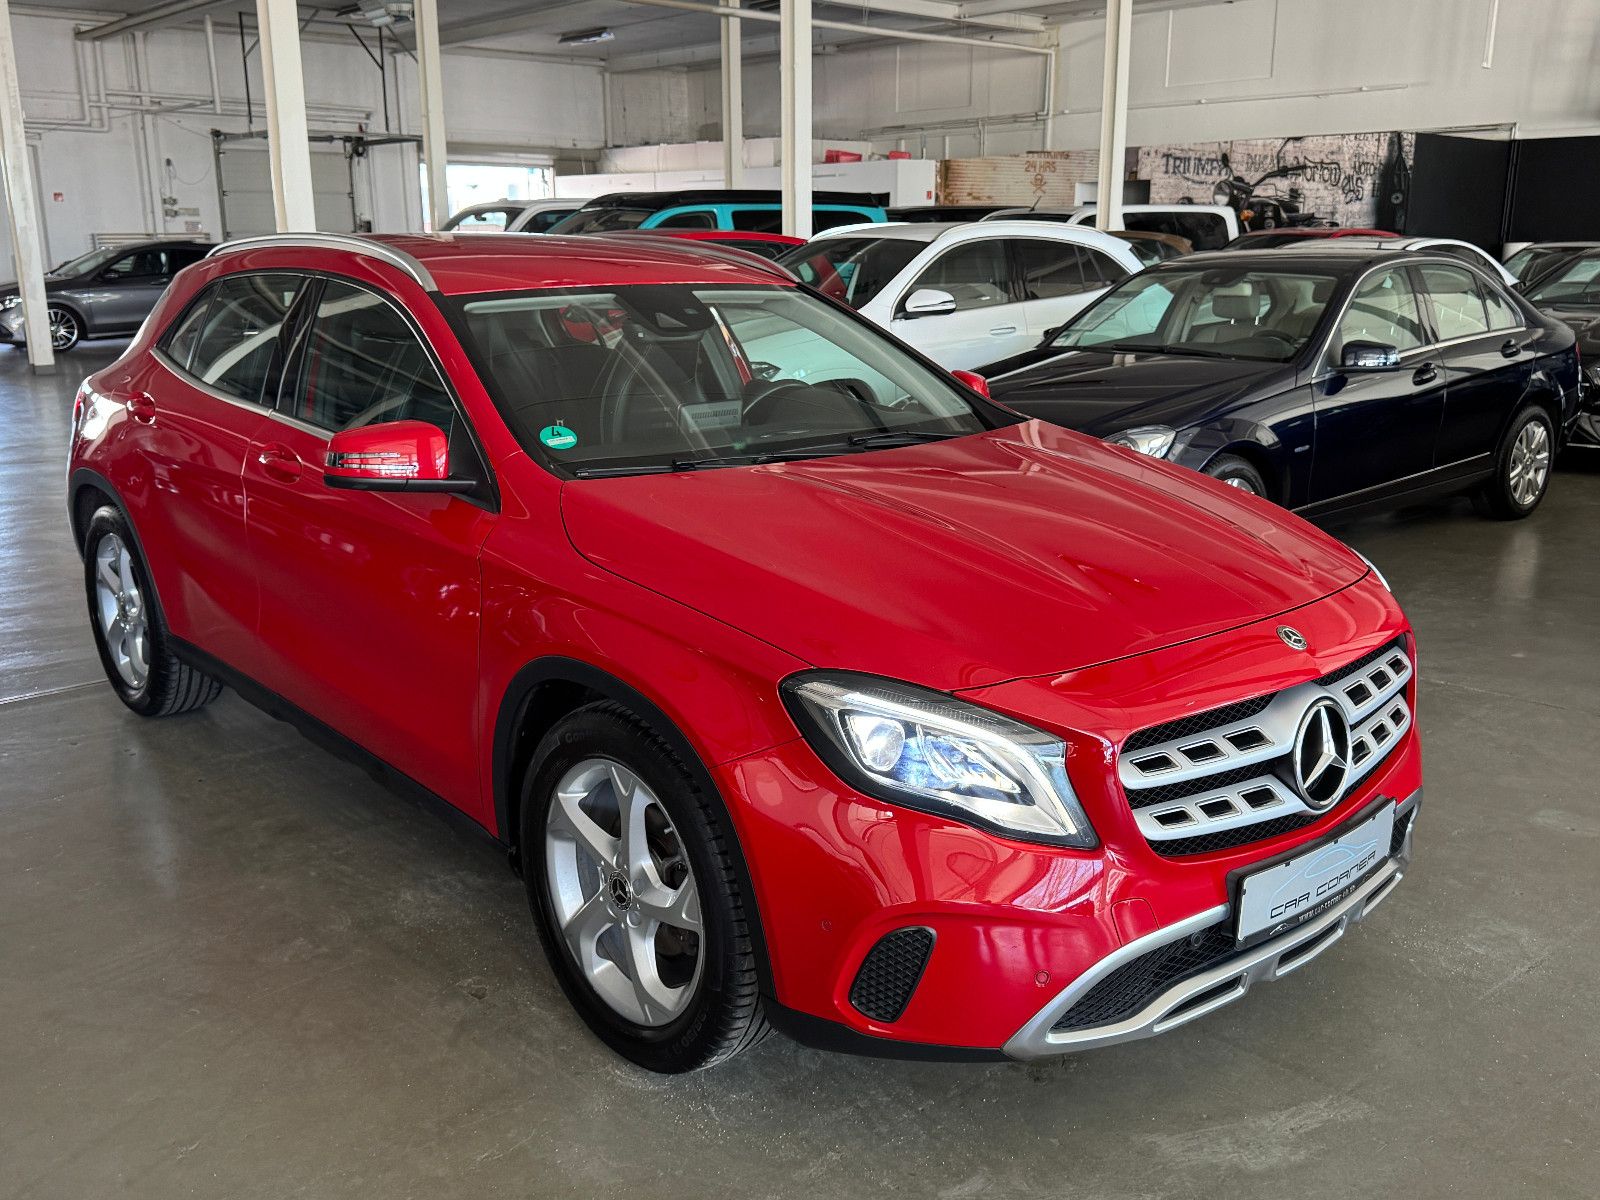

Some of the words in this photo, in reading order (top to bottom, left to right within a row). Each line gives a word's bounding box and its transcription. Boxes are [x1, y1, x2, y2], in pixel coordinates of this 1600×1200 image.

[551, 426, 562, 437] 4
[1270, 892, 1311, 919] CAR
[1316, 850, 1376, 897] CORNER
